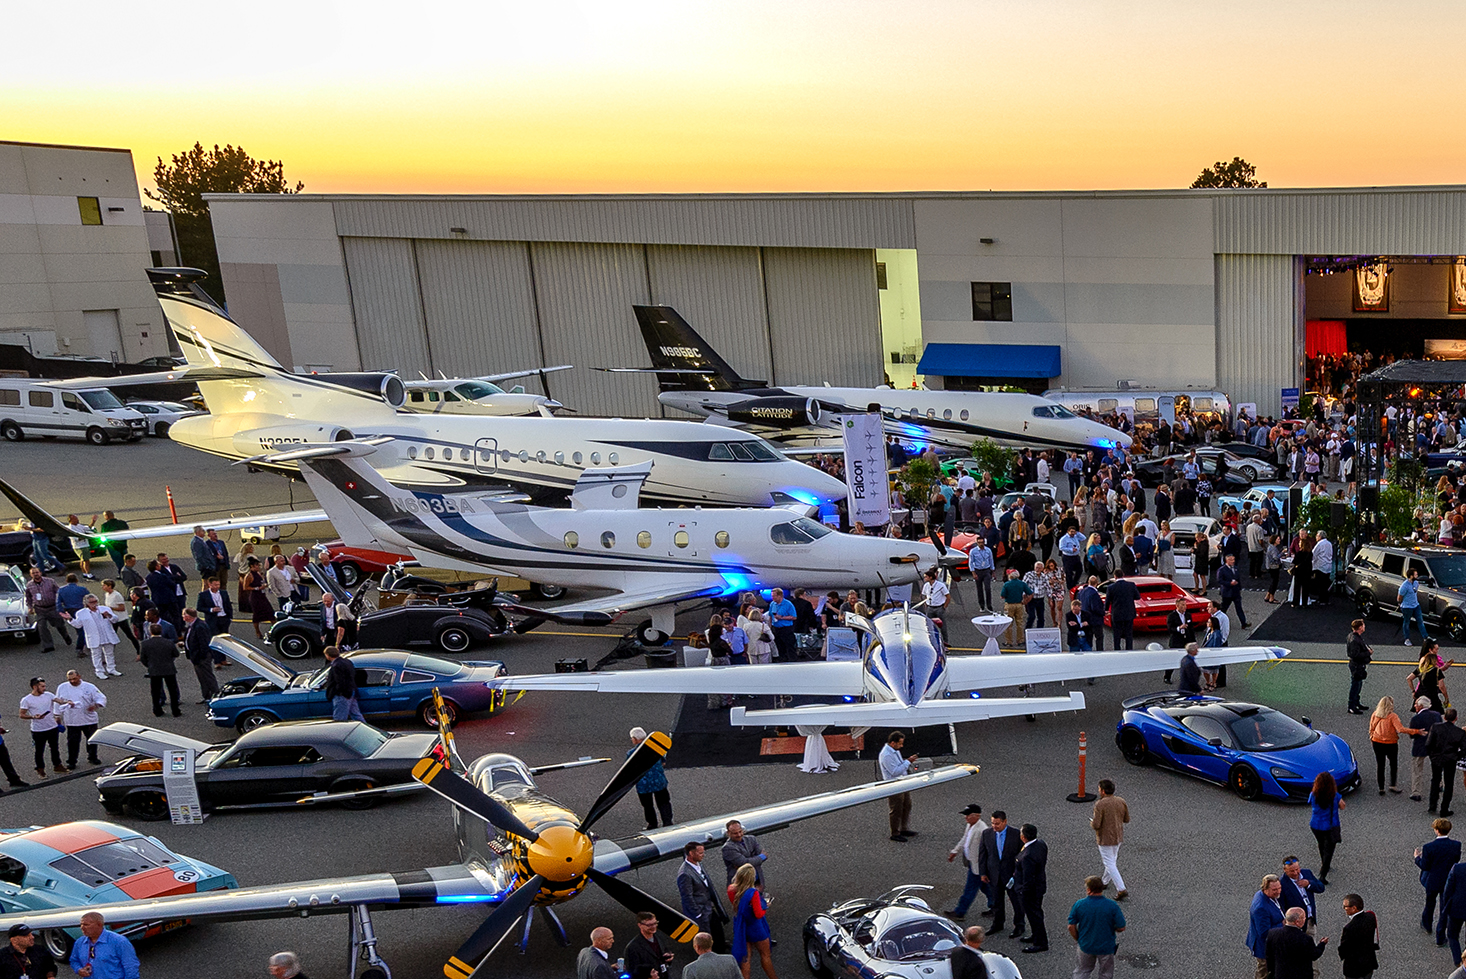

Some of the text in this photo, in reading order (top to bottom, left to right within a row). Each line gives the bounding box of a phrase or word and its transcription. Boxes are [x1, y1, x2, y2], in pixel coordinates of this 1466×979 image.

[853, 460, 866, 500] Falcon
[389, 498, 476, 514] N603BA
[178, 870, 196, 882] 80
